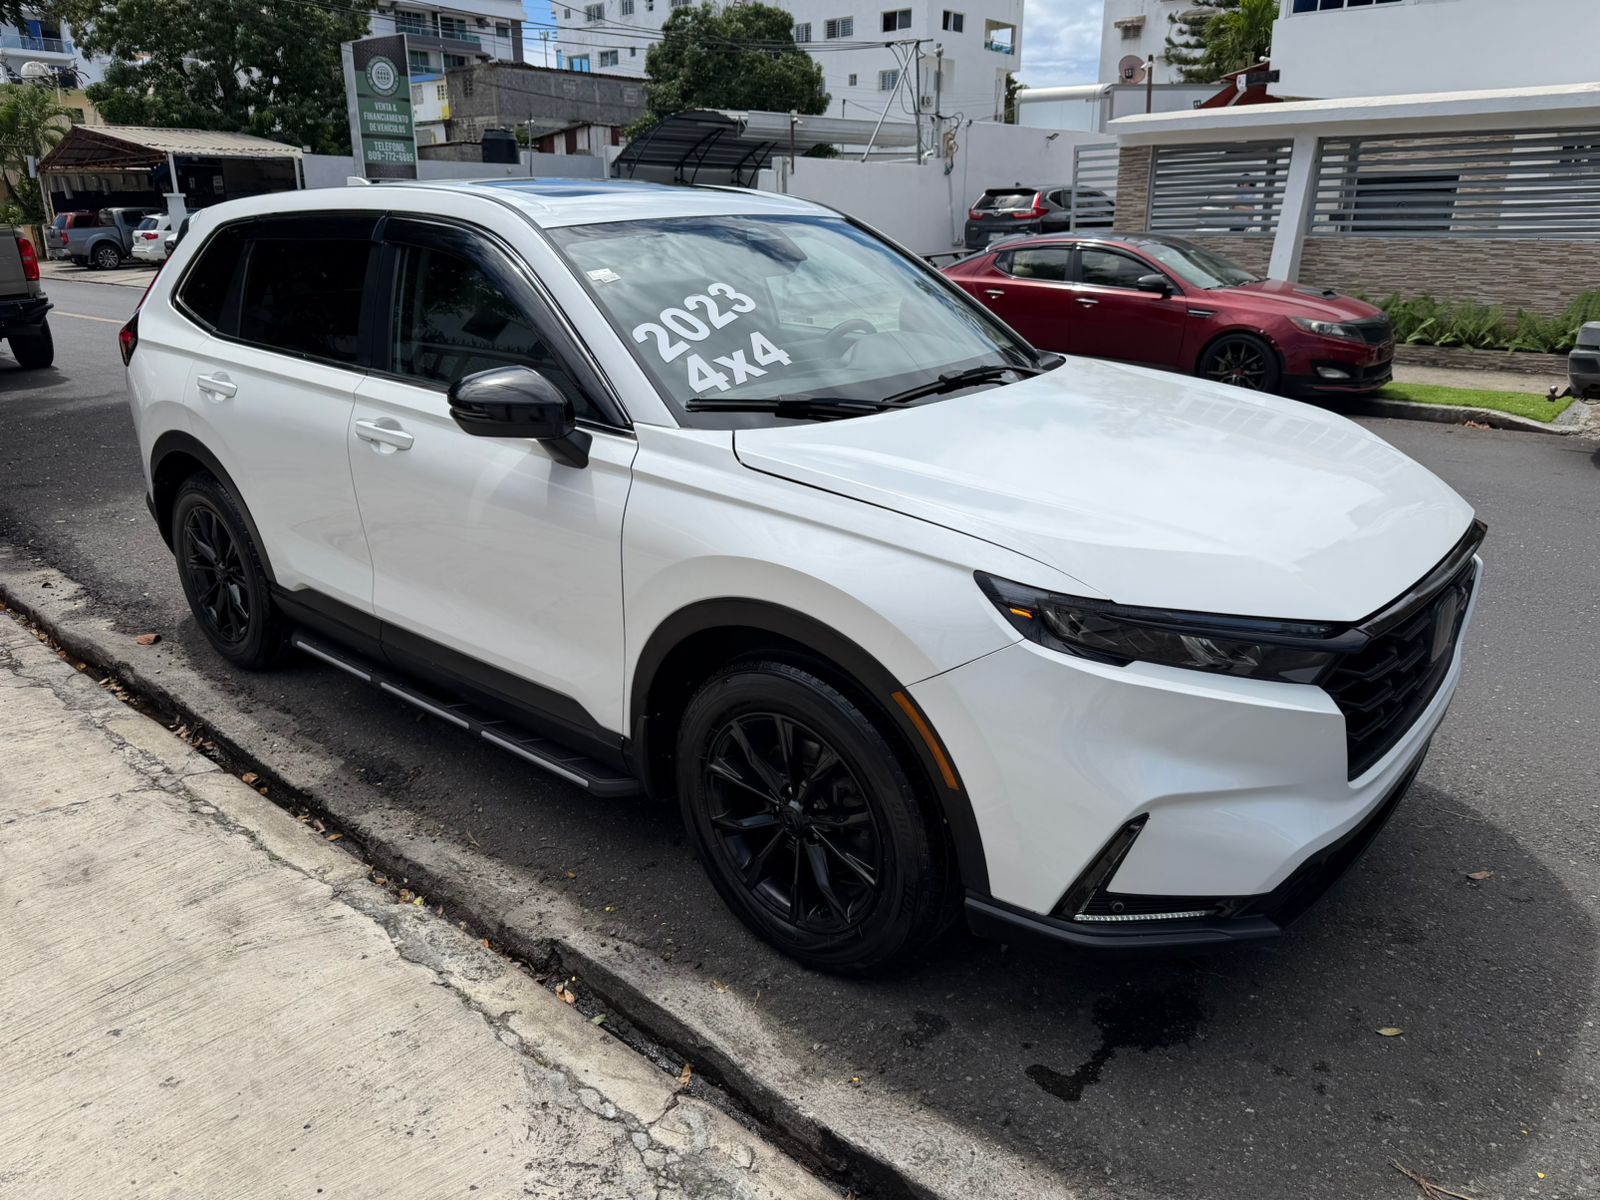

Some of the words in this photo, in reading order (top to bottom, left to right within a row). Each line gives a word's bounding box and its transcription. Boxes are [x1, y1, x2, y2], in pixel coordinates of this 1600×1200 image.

[374, 102, 392, 112] VENTA
[363, 112, 409, 124] FINANCIAMIENTO
[369, 122, 377, 131] DE
[632, 282, 756, 364] 2023
[686, 331, 793, 394] 4x4
